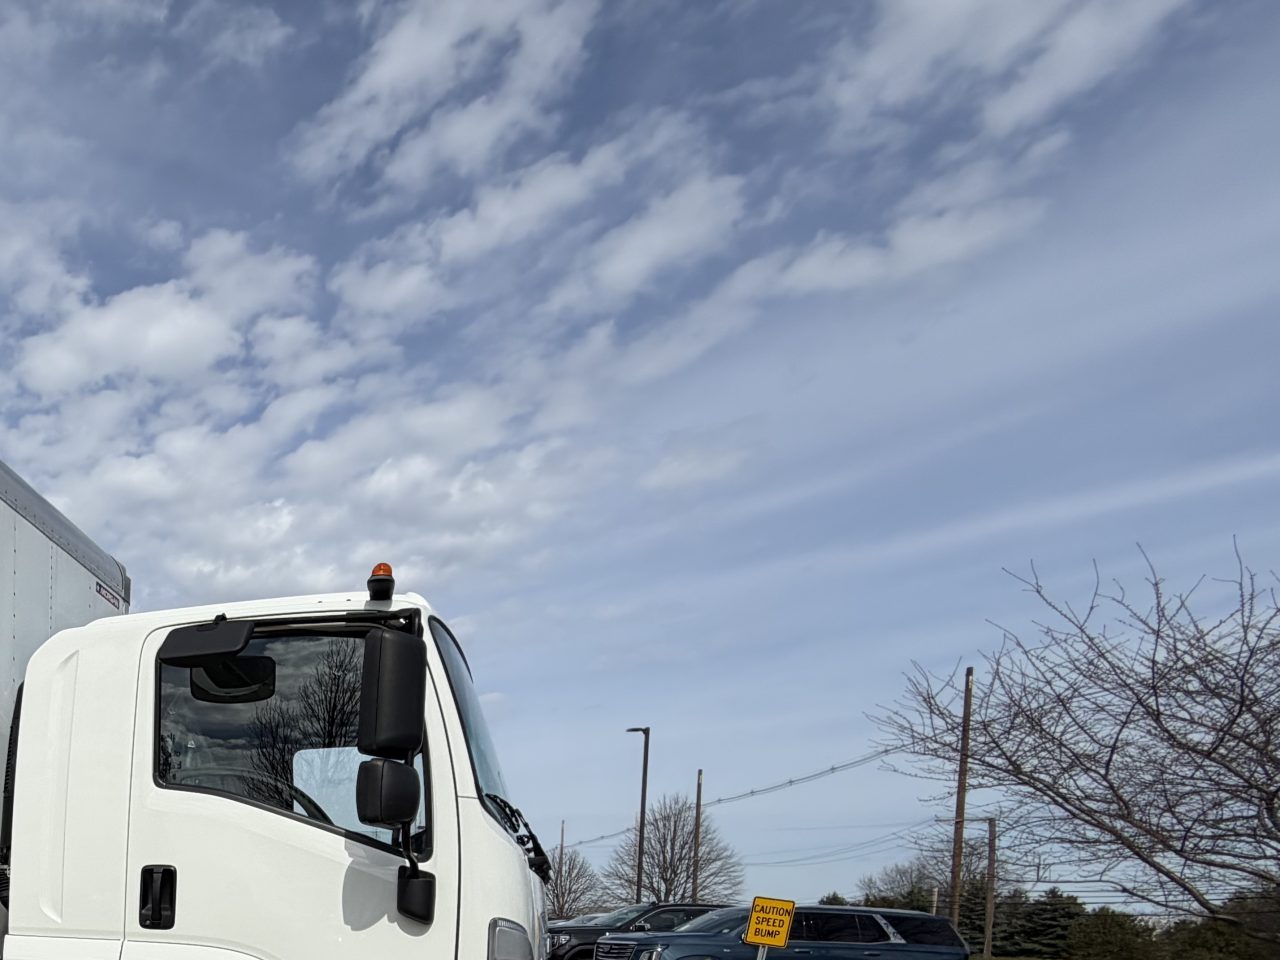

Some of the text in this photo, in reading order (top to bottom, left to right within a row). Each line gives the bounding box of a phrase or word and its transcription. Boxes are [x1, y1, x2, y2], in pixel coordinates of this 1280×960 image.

[753, 904, 792, 917] CAUTION
[755, 916, 785, 928] SPEED
[754, 928, 780, 939] BUMP
